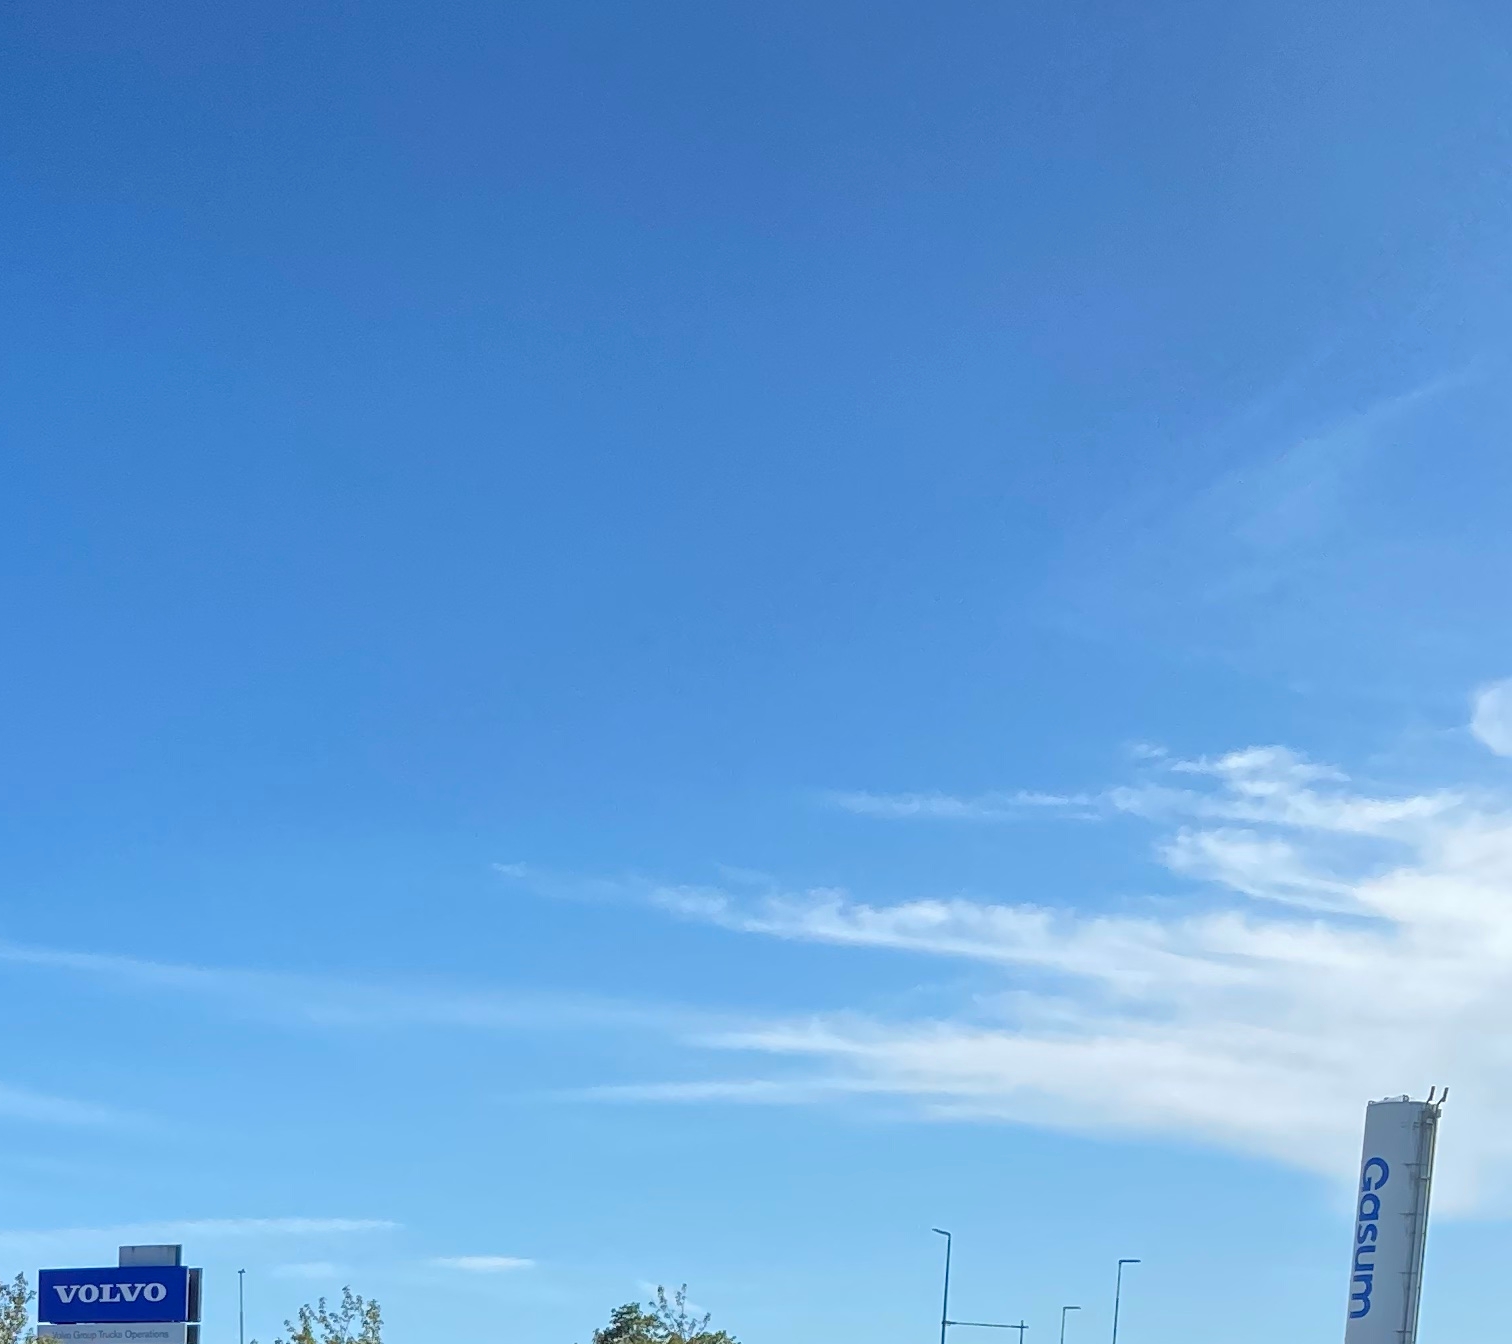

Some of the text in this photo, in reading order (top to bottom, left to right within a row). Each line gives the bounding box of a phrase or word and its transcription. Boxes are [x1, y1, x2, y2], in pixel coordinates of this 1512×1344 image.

[1349, 1157, 1390, 1319] Gasum
[53, 1283, 167, 1304] VOLVO
[73, 1331, 97, 1341] Group
[98, 1330, 123, 1339] Trucks
[125, 1329, 169, 1340] Operations
